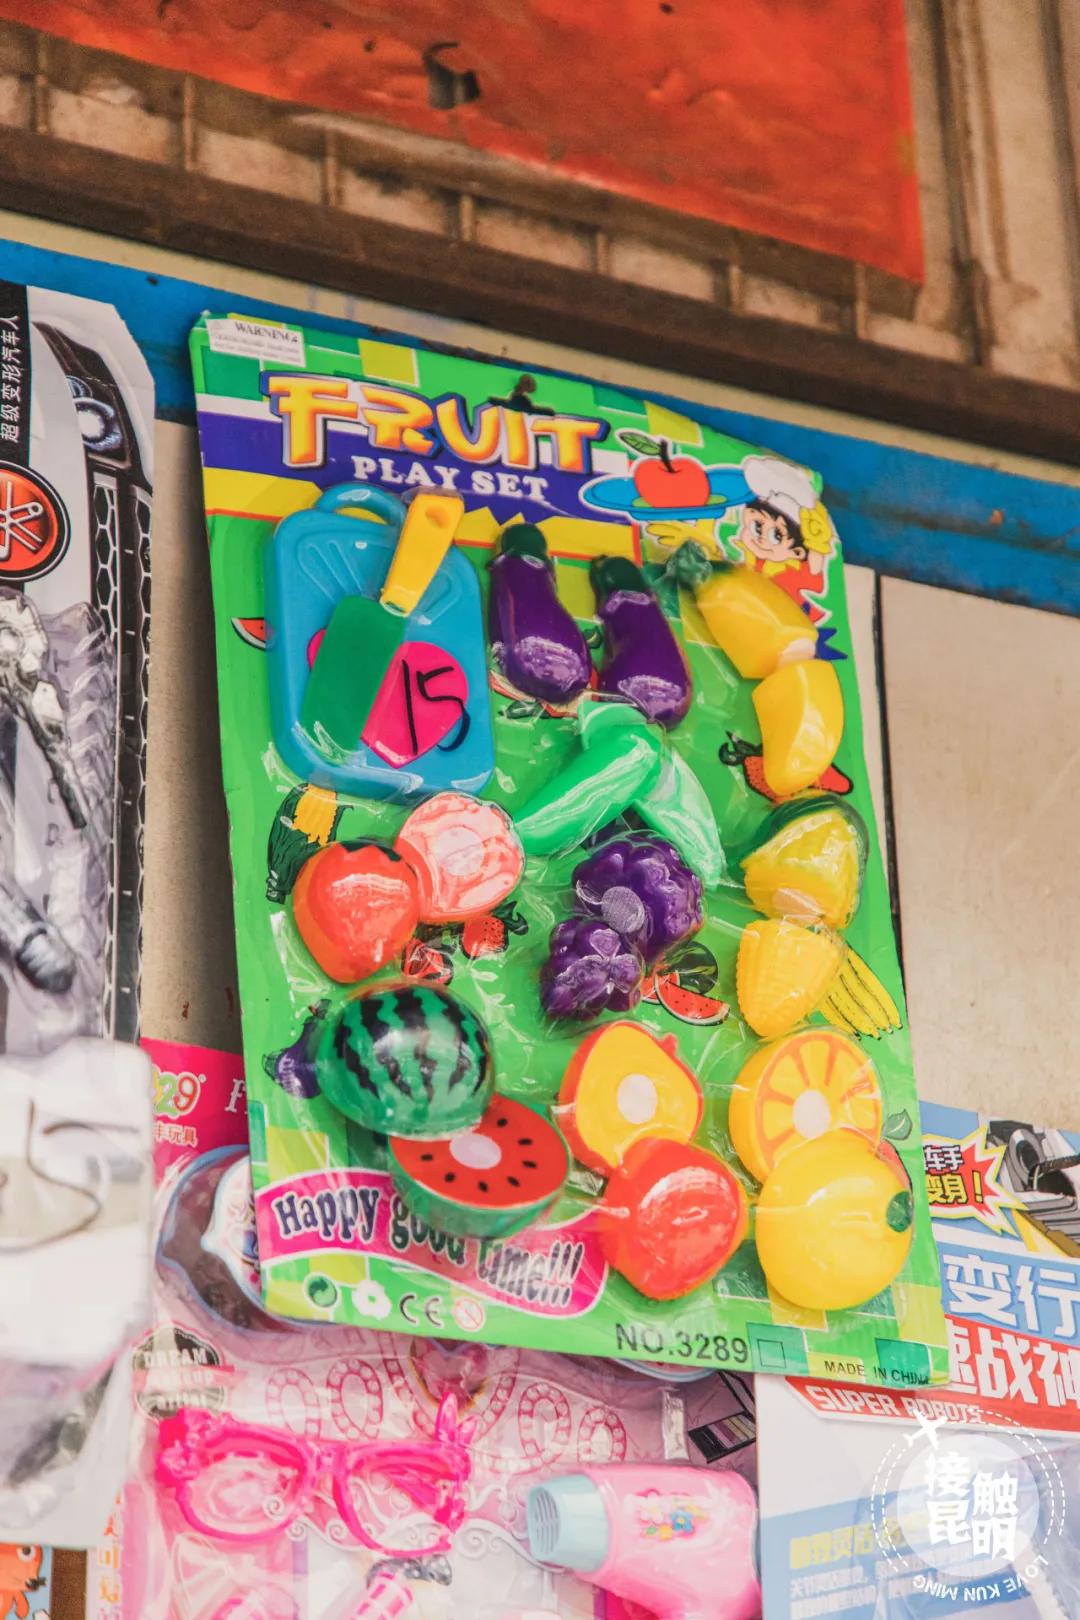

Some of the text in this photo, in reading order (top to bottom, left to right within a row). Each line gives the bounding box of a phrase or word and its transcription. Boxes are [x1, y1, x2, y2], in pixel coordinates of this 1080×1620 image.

[0, 314, 21, 443] 超级变形汽车人
[260, 372, 609, 473] FRUIT
[351, 455, 549, 501] PLAY SET
[401, 658, 471, 756] 15
[273, 1188, 380, 1242] Happy
[943, 1254, 1080, 1338] 变行
[615, 1322, 749, 1364] NO.3289
[824, 1360, 867, 1377] MADE
[873, 1366, 887, 1378] IN
[803, 1385, 987, 1424] SUPER ROBOTS
